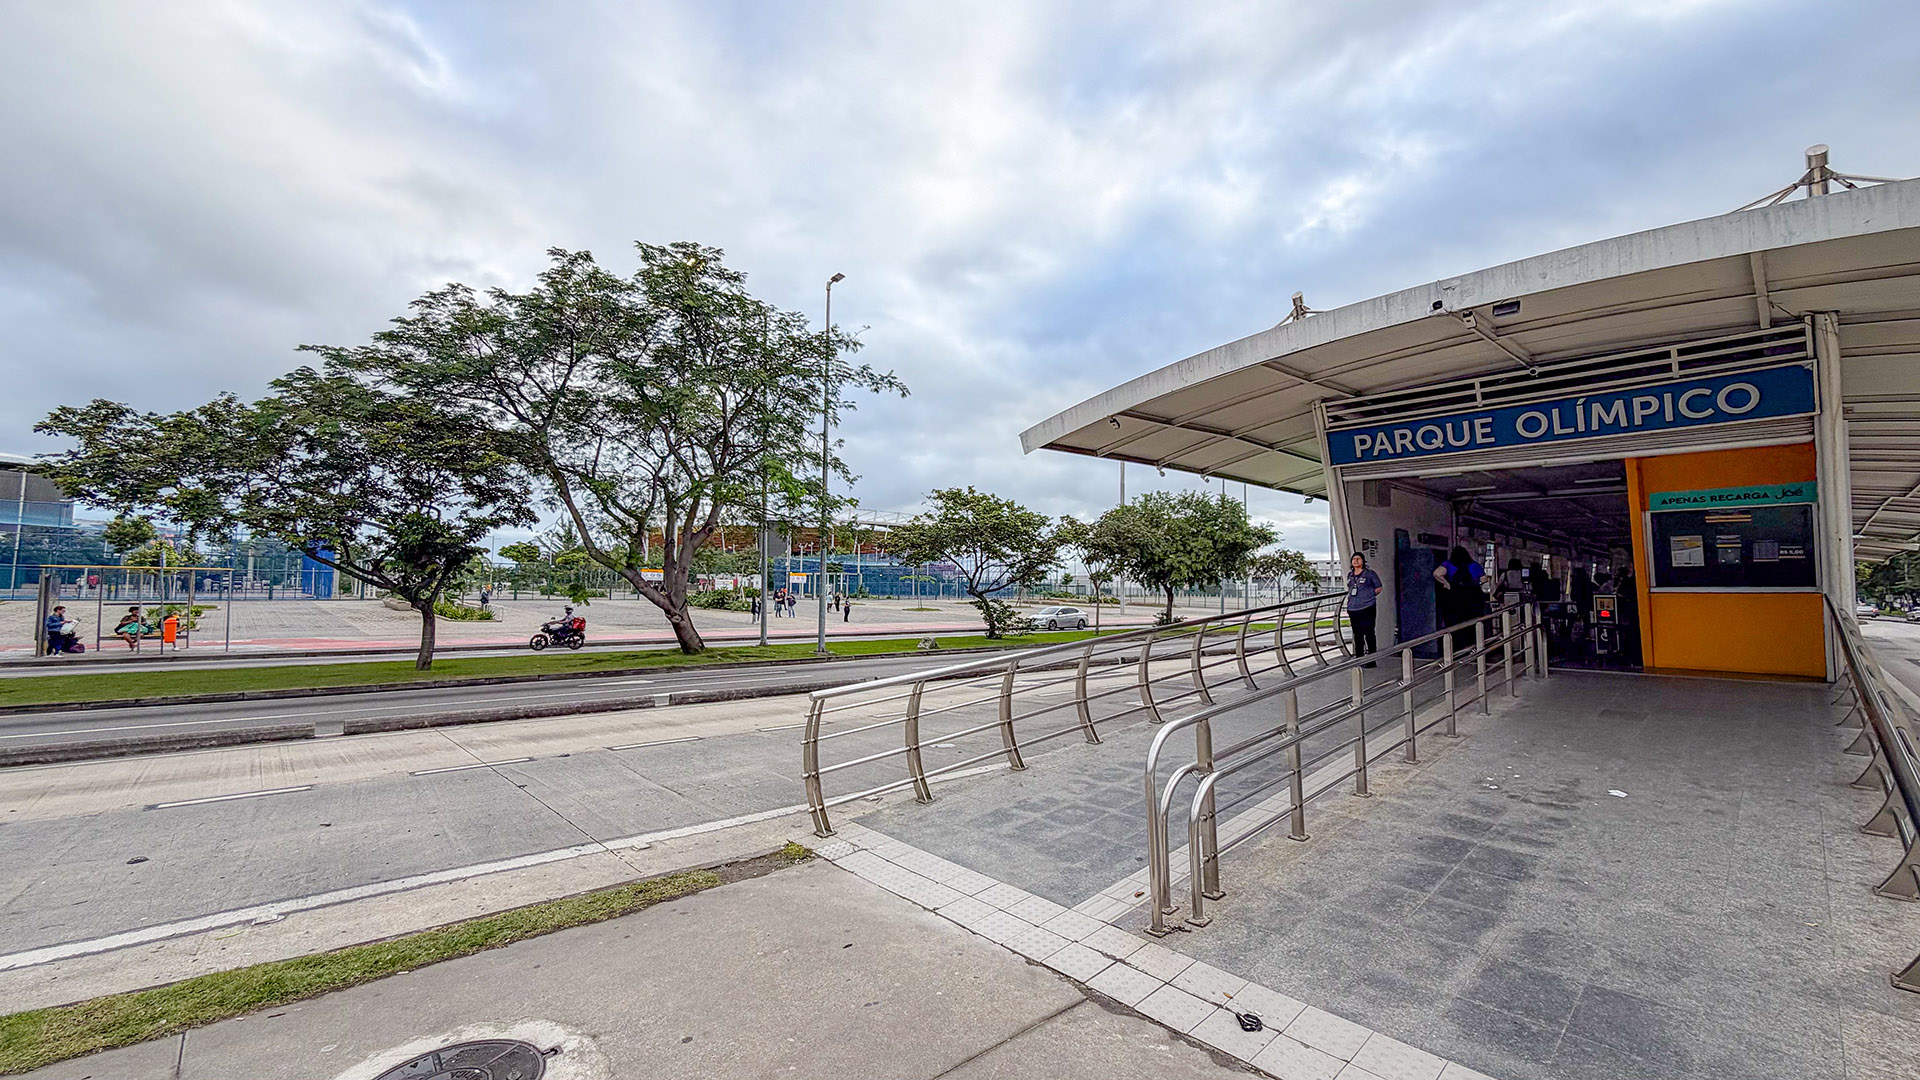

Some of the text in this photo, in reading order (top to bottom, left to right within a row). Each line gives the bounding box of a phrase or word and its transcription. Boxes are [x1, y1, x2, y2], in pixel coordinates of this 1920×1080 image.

[1354, 381, 1761, 458] PARQUE OLÍMPICO
[1661, 495, 1706, 505] APENAS
[1710, 491, 1770, 503] RECARGA
